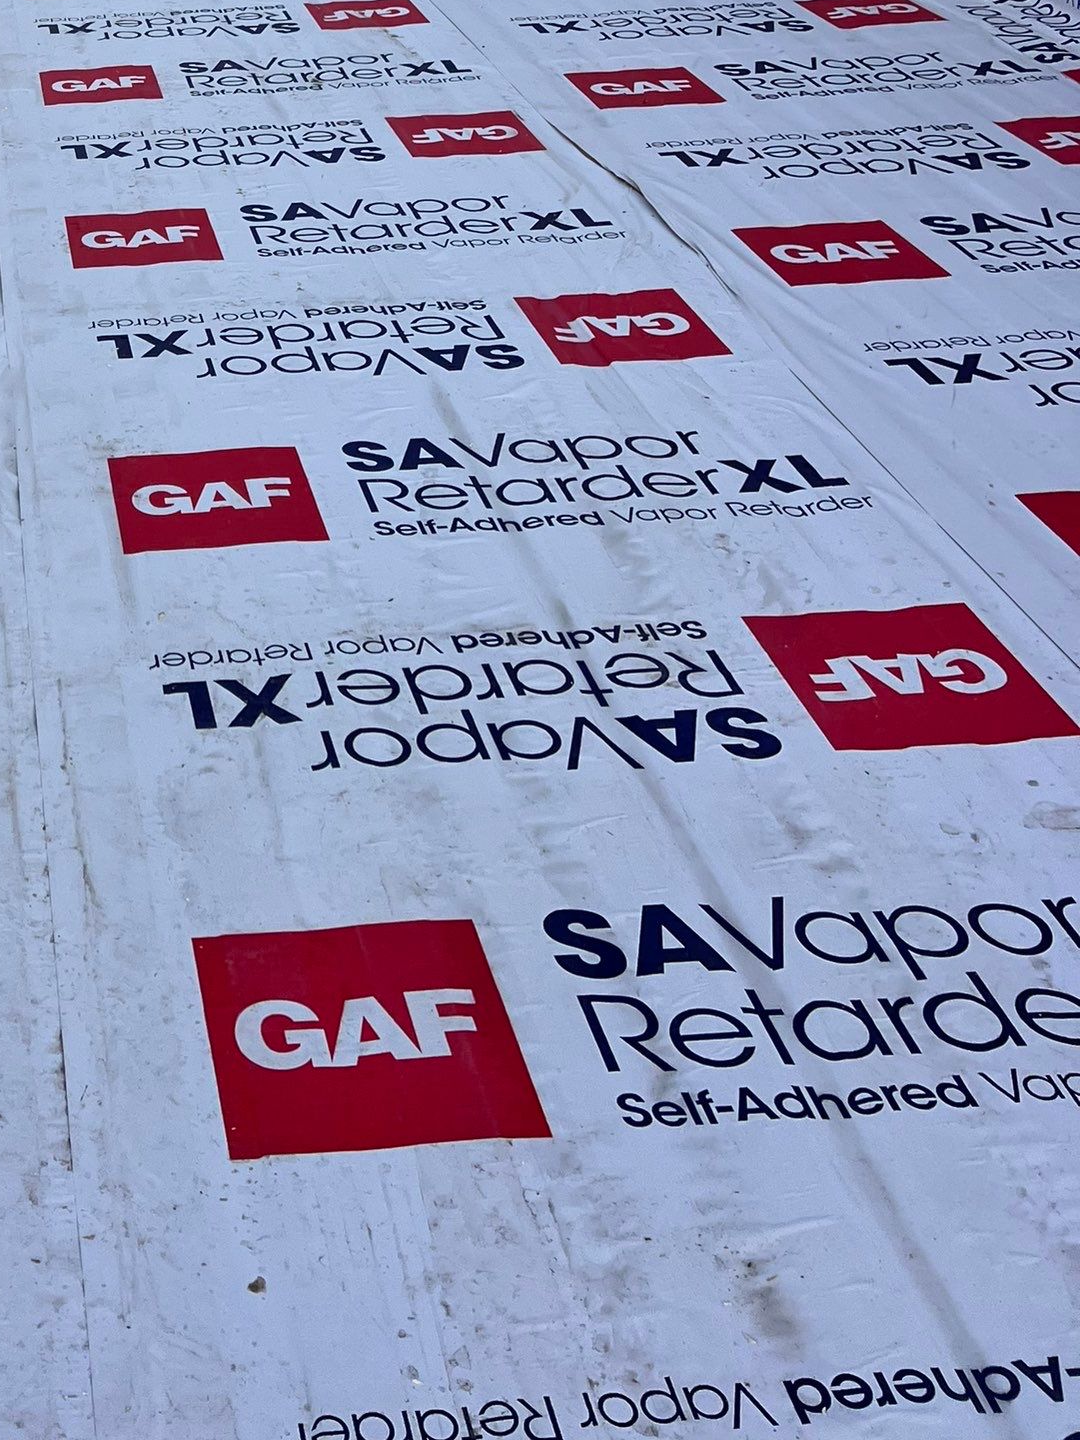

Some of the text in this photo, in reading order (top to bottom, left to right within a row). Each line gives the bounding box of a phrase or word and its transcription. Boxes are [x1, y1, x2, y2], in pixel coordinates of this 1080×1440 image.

[324, 7, 410, 21] GAF
[826, 2, 919, 18] GAF
[52, 76, 146, 92] GAF
[590, 80, 691, 95] GAF
[732, 60, 1042, 93] RetarderXL
[61, 128, 373, 160] RetarderXL
[412, 126, 518, 143] GAF
[821, 123, 973, 139] Self-Adhered
[658, 133, 1002, 168] RetarderXL
[81, 226, 200, 248] GAF
[249, 209, 613, 245] RetarderXL
[257, 242, 426, 259] Self-Adhered
[770, 241, 899, 263] GAF
[213, 309, 296, 325] Vapor
[304, 300, 486, 318] Self-Adhered
[97, 314, 505, 359] RetarderXL
[554, 313, 690, 342] GAF
[864, 336, 991, 352] Retarder
[197, 344, 524, 378] SAVapor
[342, 431, 699, 472] SAVapor
[132, 477, 291, 515] GAF
[358, 455, 850, 513] RetarderXL
[374, 496, 872, 536] Self-Adhered Vapor Retarder
[149, 621, 707, 670] Self-Adhered Vapor Retarder
[162, 649, 744, 729] RetarderXL
[809, 649, 1007, 701] GAF
[311, 707, 782, 771] SAVapor
[543, 897, 1080, 980] SAVapor
[235, 989, 477, 1070] GAF
[577, 972, 1080, 1072] Retarde
[617, 1075, 979, 1128] Self-Adhered
[581, 1376, 777, 1430] Vapor
